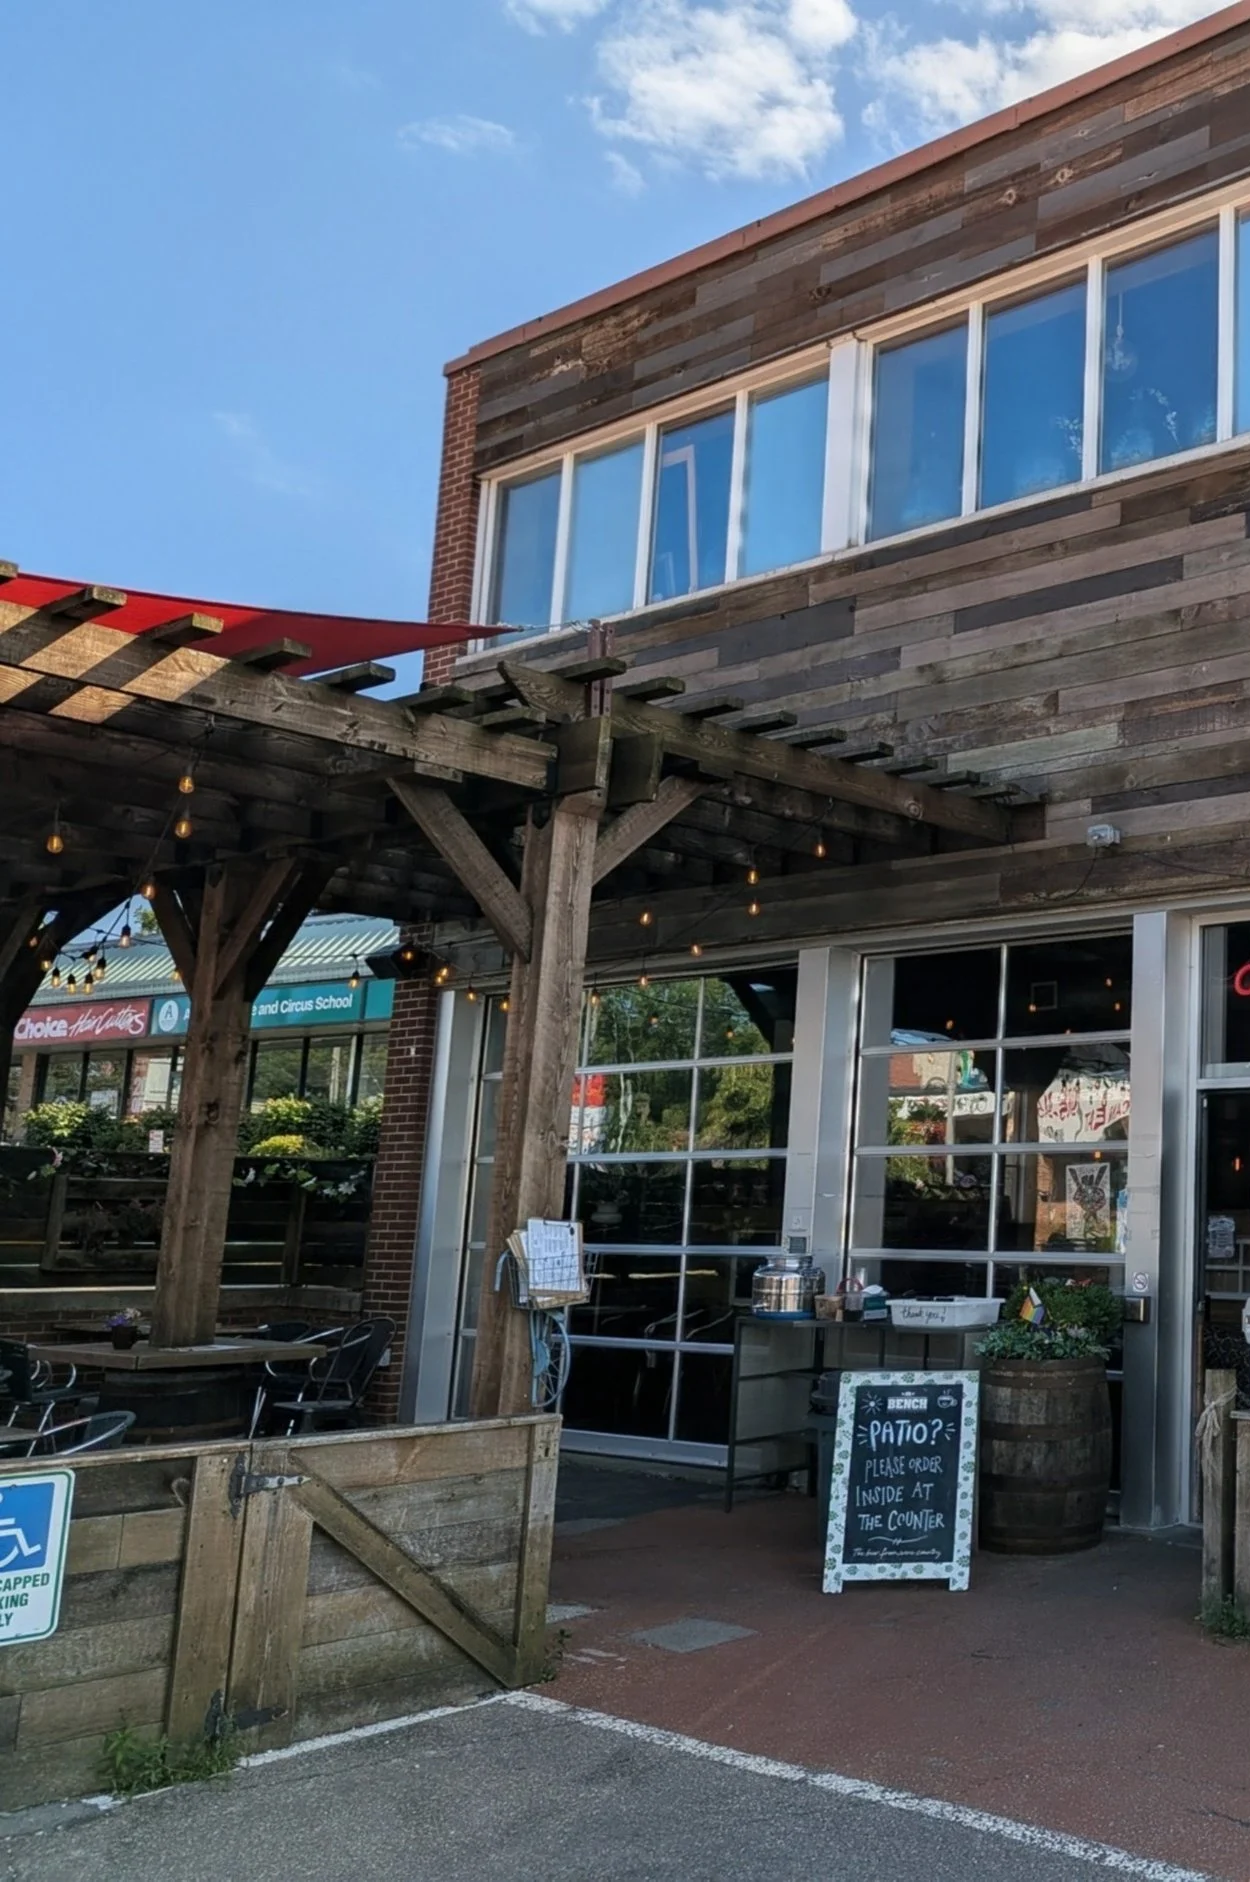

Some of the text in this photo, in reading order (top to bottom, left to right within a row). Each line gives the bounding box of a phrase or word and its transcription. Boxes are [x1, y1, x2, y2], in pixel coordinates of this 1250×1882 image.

[258, 1002, 278, 1015] and
[280, 999, 313, 1014] Circus
[315, 994, 353, 1010] School
[14, 1016, 68, 1039] Choice
[887, 1396, 928, 1411] BENCH
[870, 1418, 943, 1452] PATIO?
[864, 1455, 943, 1484] PLEASE ORDER
[856, 1481, 934, 1507] INSIDE AT
[858, 1509, 945, 1532] THE COUNTER
